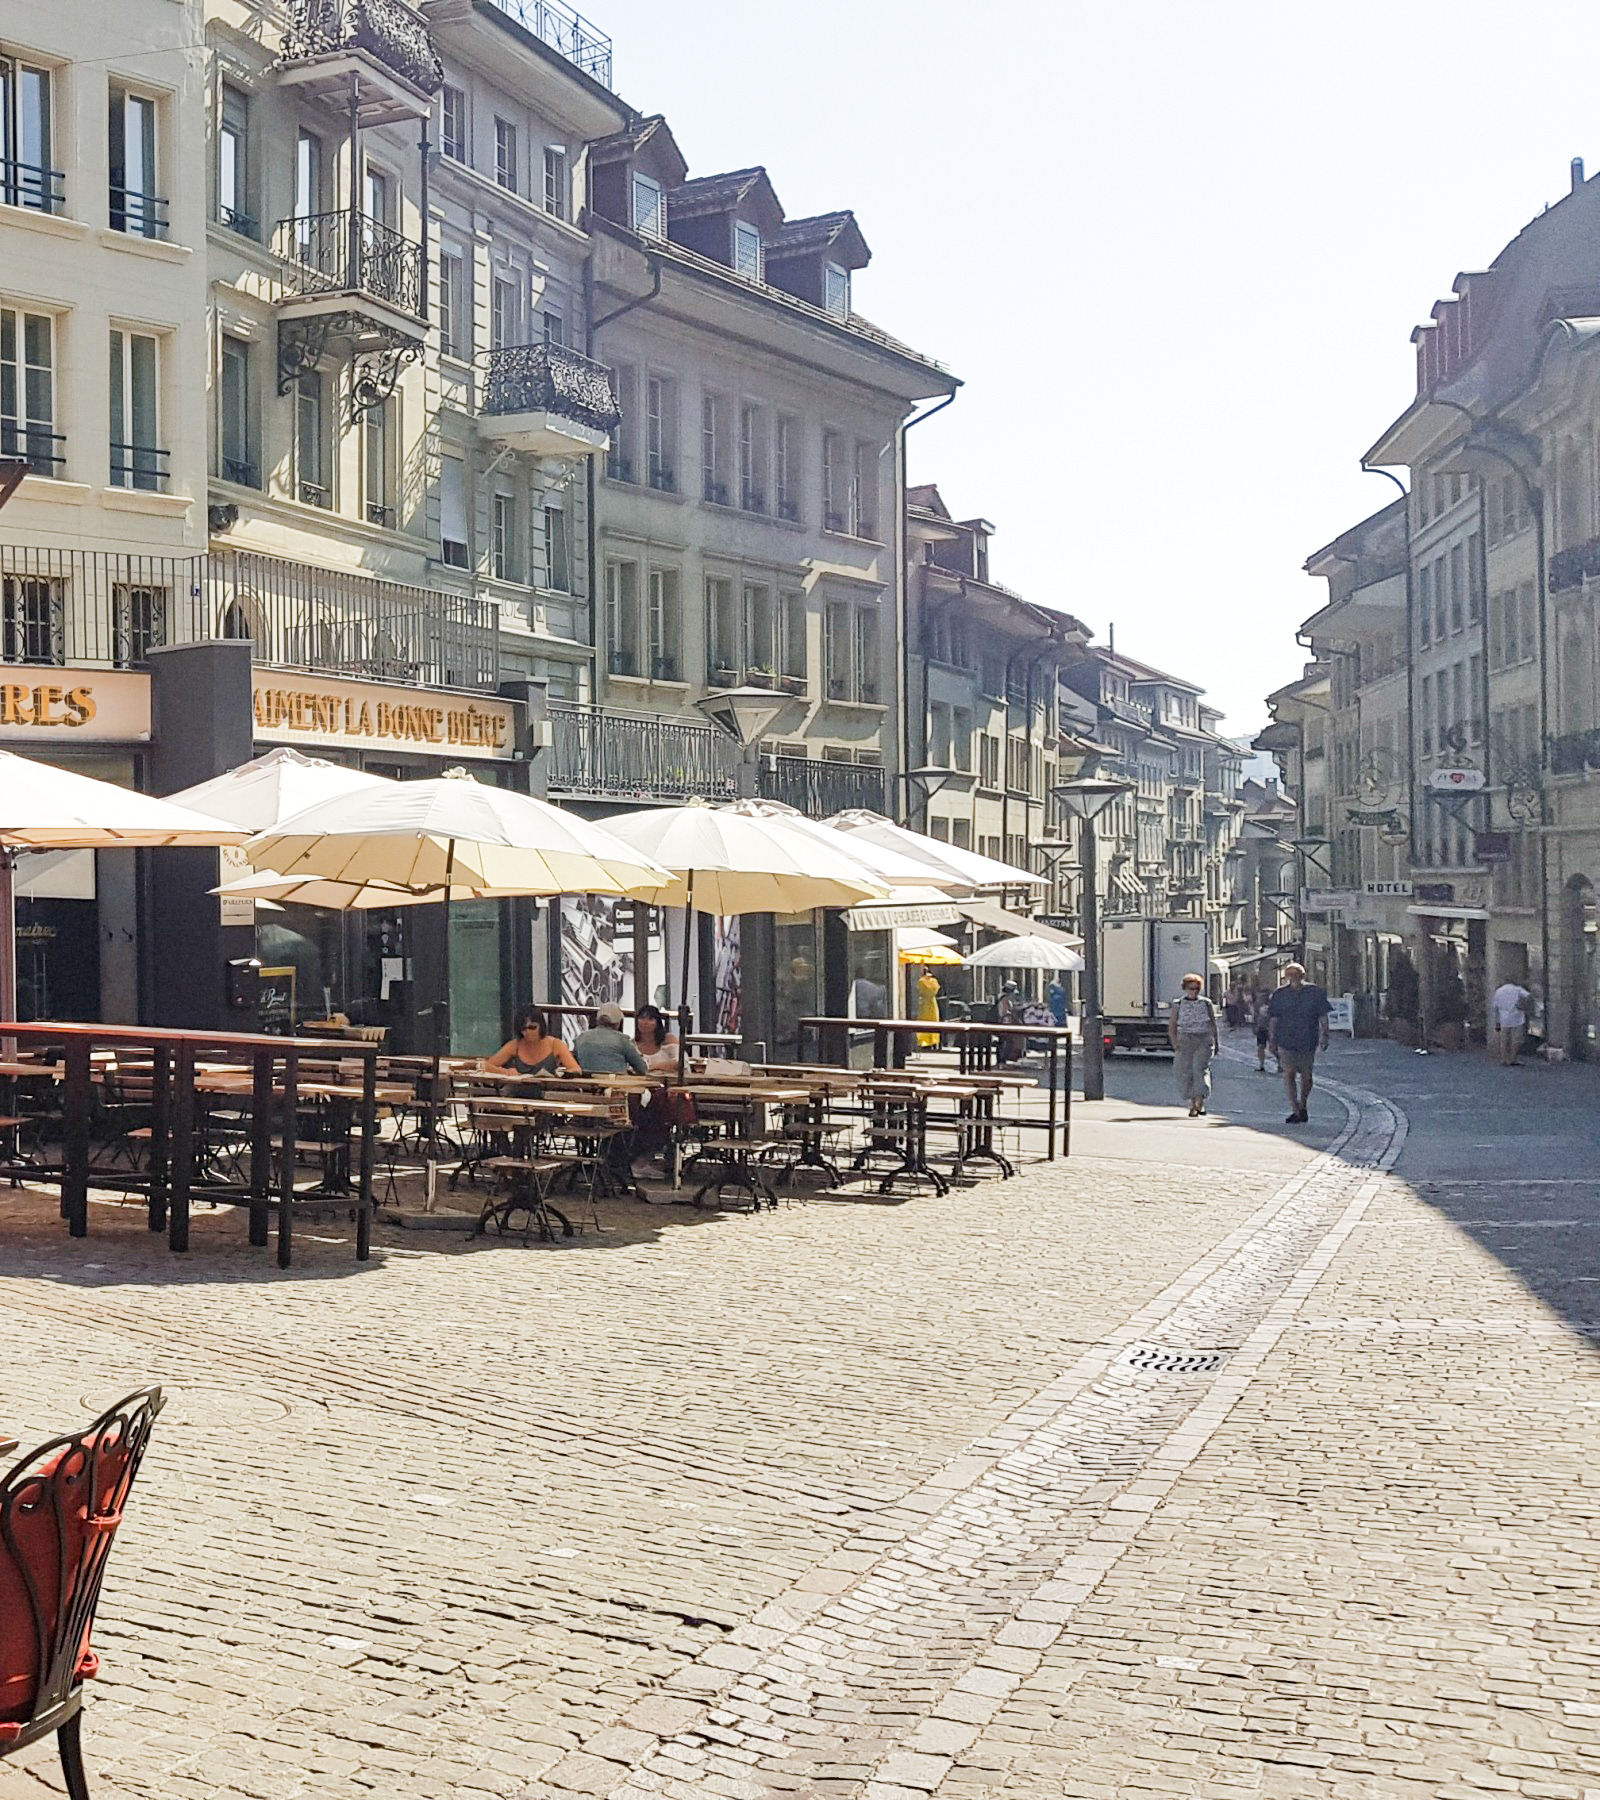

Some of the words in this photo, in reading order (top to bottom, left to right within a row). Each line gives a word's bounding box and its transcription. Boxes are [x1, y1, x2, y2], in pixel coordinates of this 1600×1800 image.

[344, 696, 375, 738] LA
[376, 701, 446, 744] BONNE
[446, 704, 508, 749] BIÈRE
[1367, 883, 1409, 893] HOTEL
